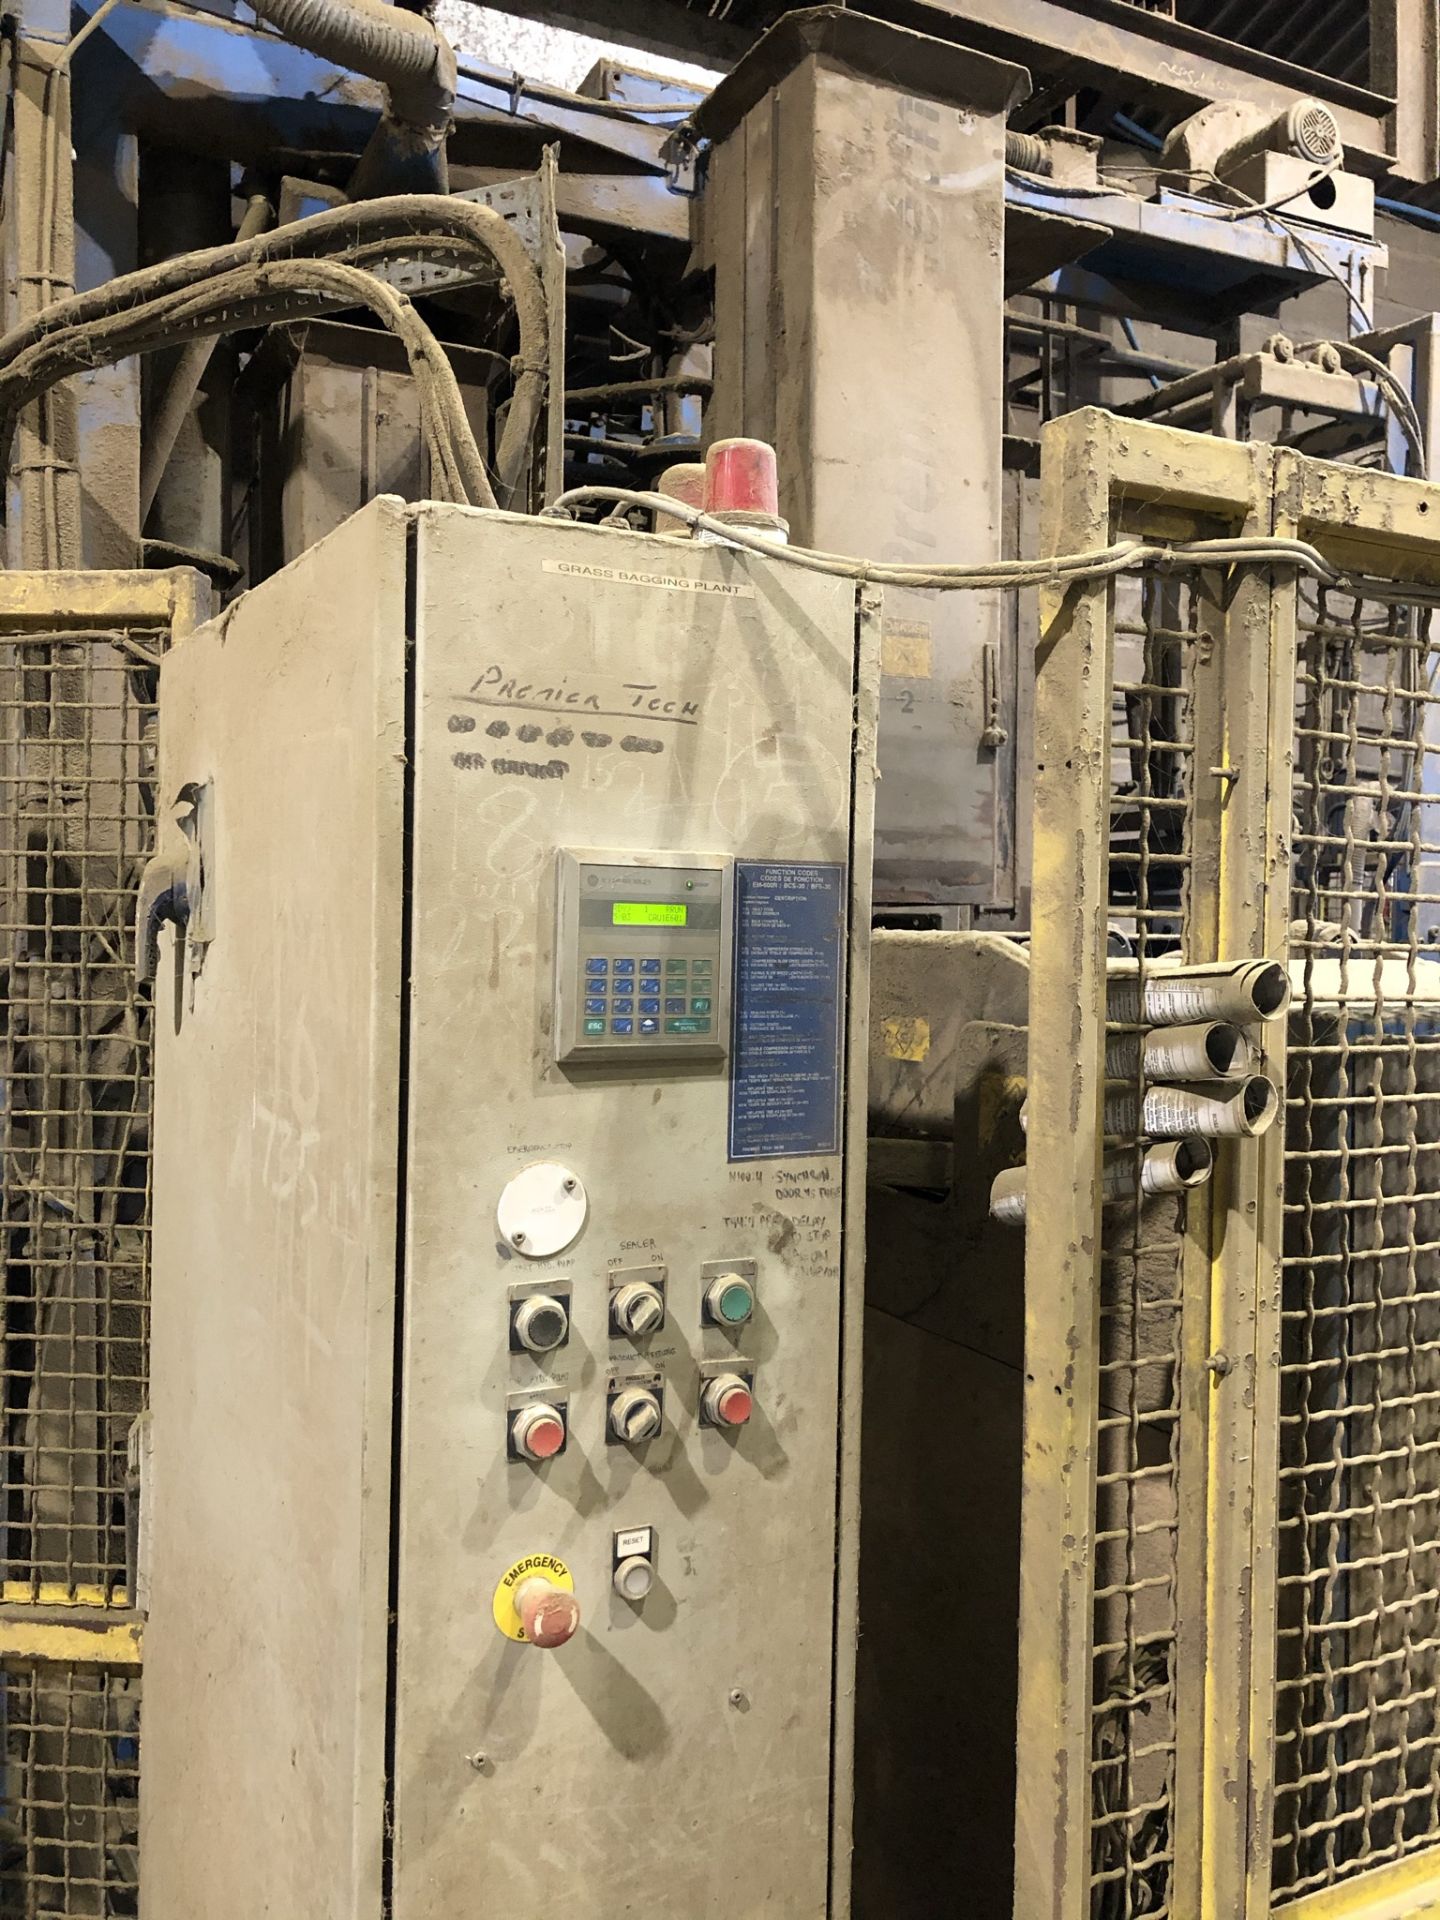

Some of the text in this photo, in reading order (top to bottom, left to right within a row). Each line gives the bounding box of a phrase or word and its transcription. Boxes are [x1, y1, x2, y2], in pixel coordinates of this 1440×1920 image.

[557, 562, 742, 594] GRASS BAGGING PLANT
[900, 690, 914, 713] 2
[765, 868, 796, 876] FUNCTION
[588, 1022, 603, 1030] ESC
[775, 1188, 804, 1200] DOOR
[619, 1238, 656, 1250] SEALER
[607, 1253, 664, 1266] OFF ON
[655, 1361, 666, 1369] ON
[622, 1536, 644, 1546] RESET
[503, 1556, 568, 1588] EMERGENCY
